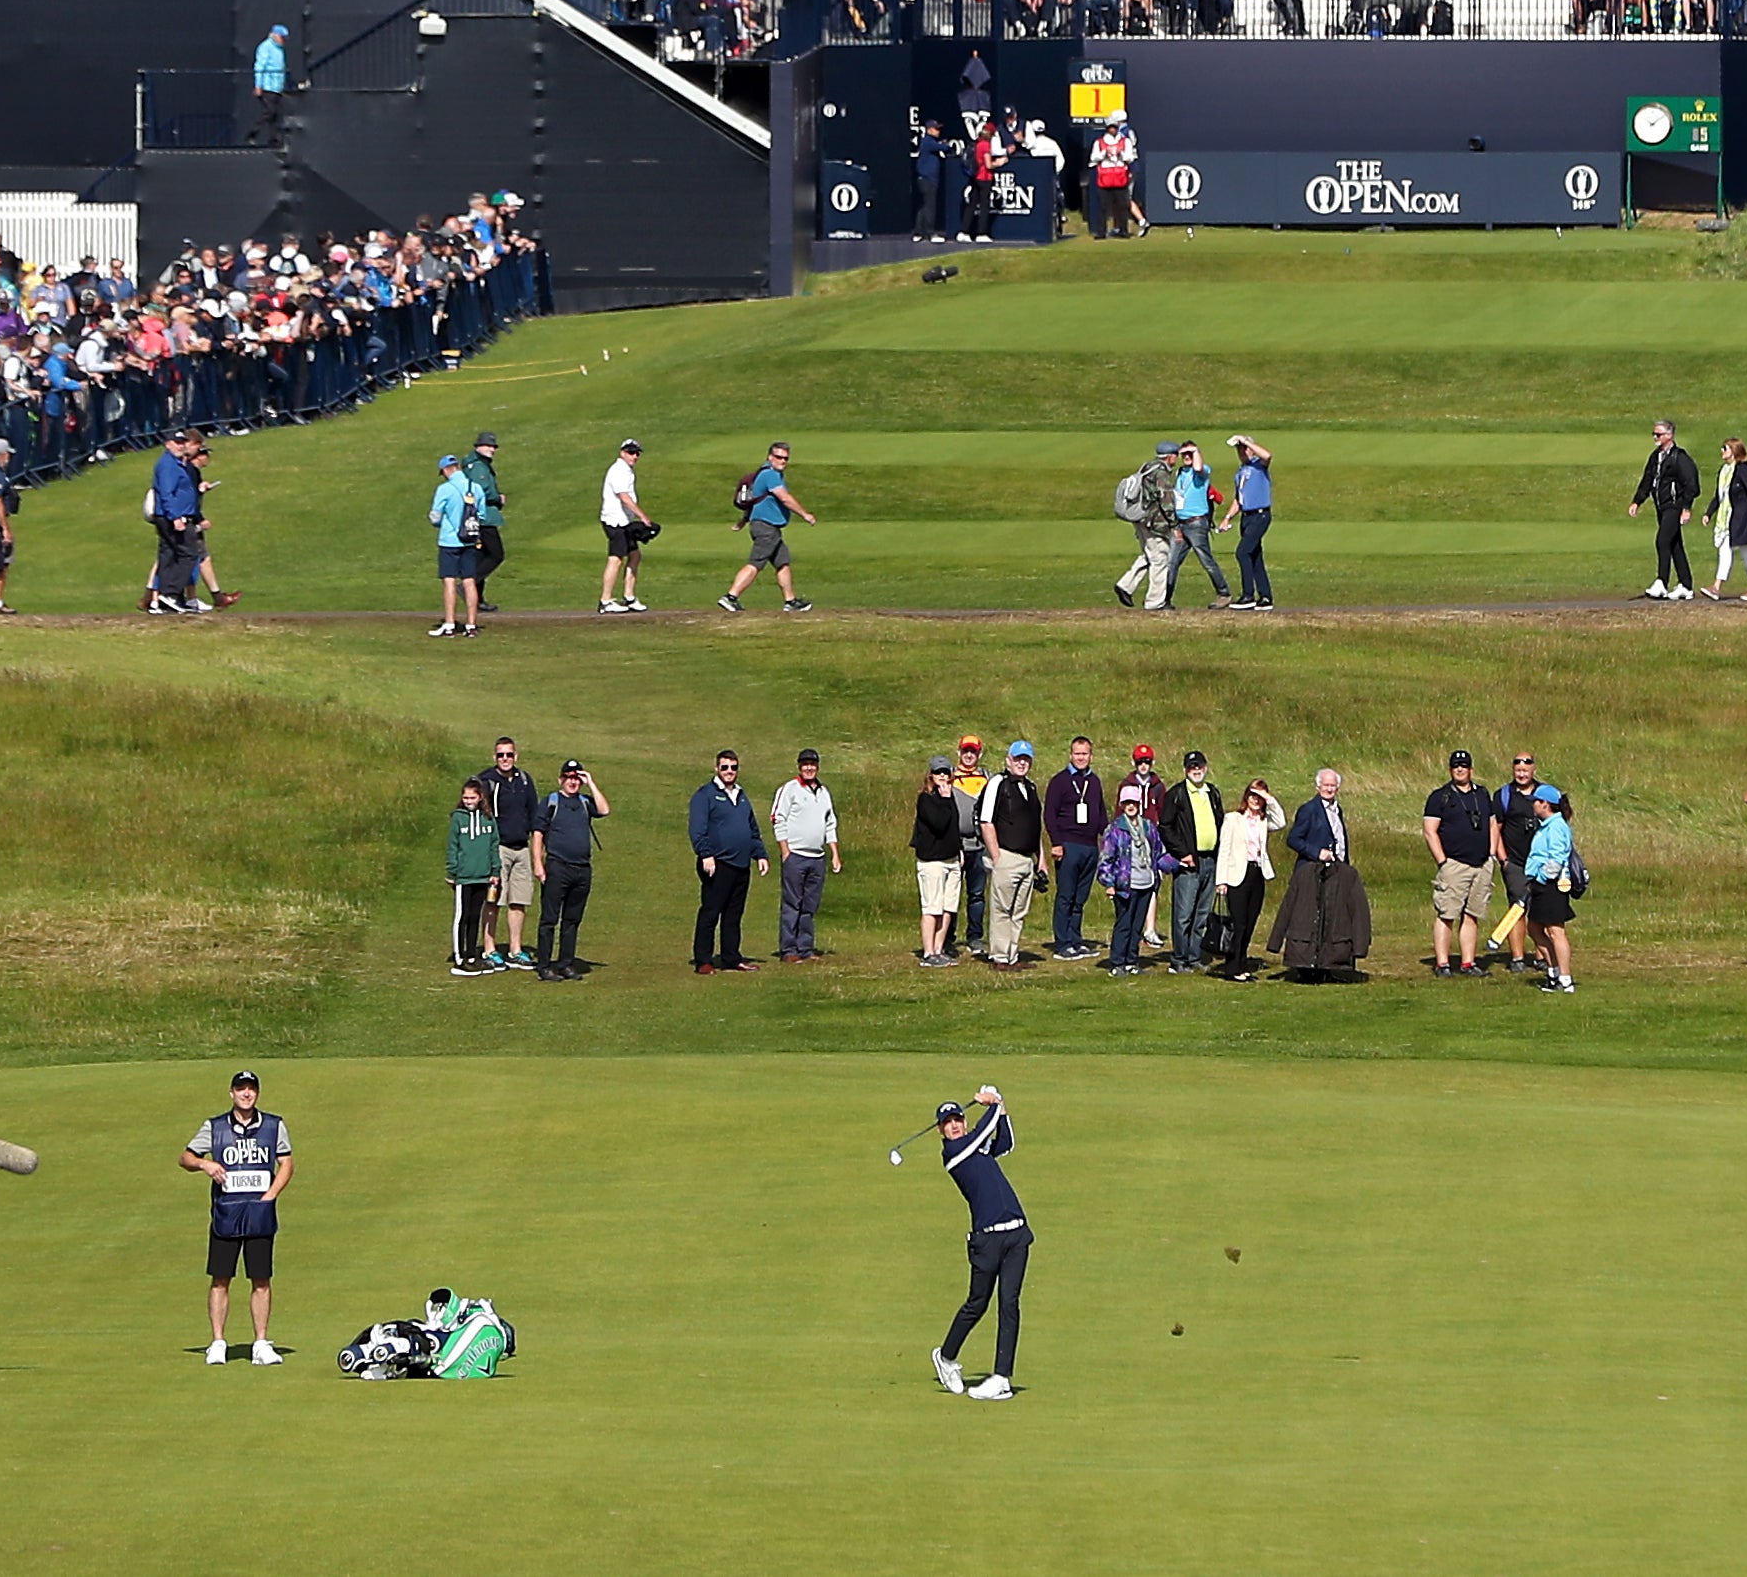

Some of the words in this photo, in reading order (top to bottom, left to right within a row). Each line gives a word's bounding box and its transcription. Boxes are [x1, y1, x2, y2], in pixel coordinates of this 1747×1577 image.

[1092, 88, 1102, 113] 1
[1681, 112, 1717, 122] ROLEX
[1336, 160, 1382, 180] THE
[994, 172, 1016, 187] HE
[235, 1138, 257, 1151] THE
[223, 1146, 269, 1165] OPEN
[231, 1175, 262, 1188] TURNER
